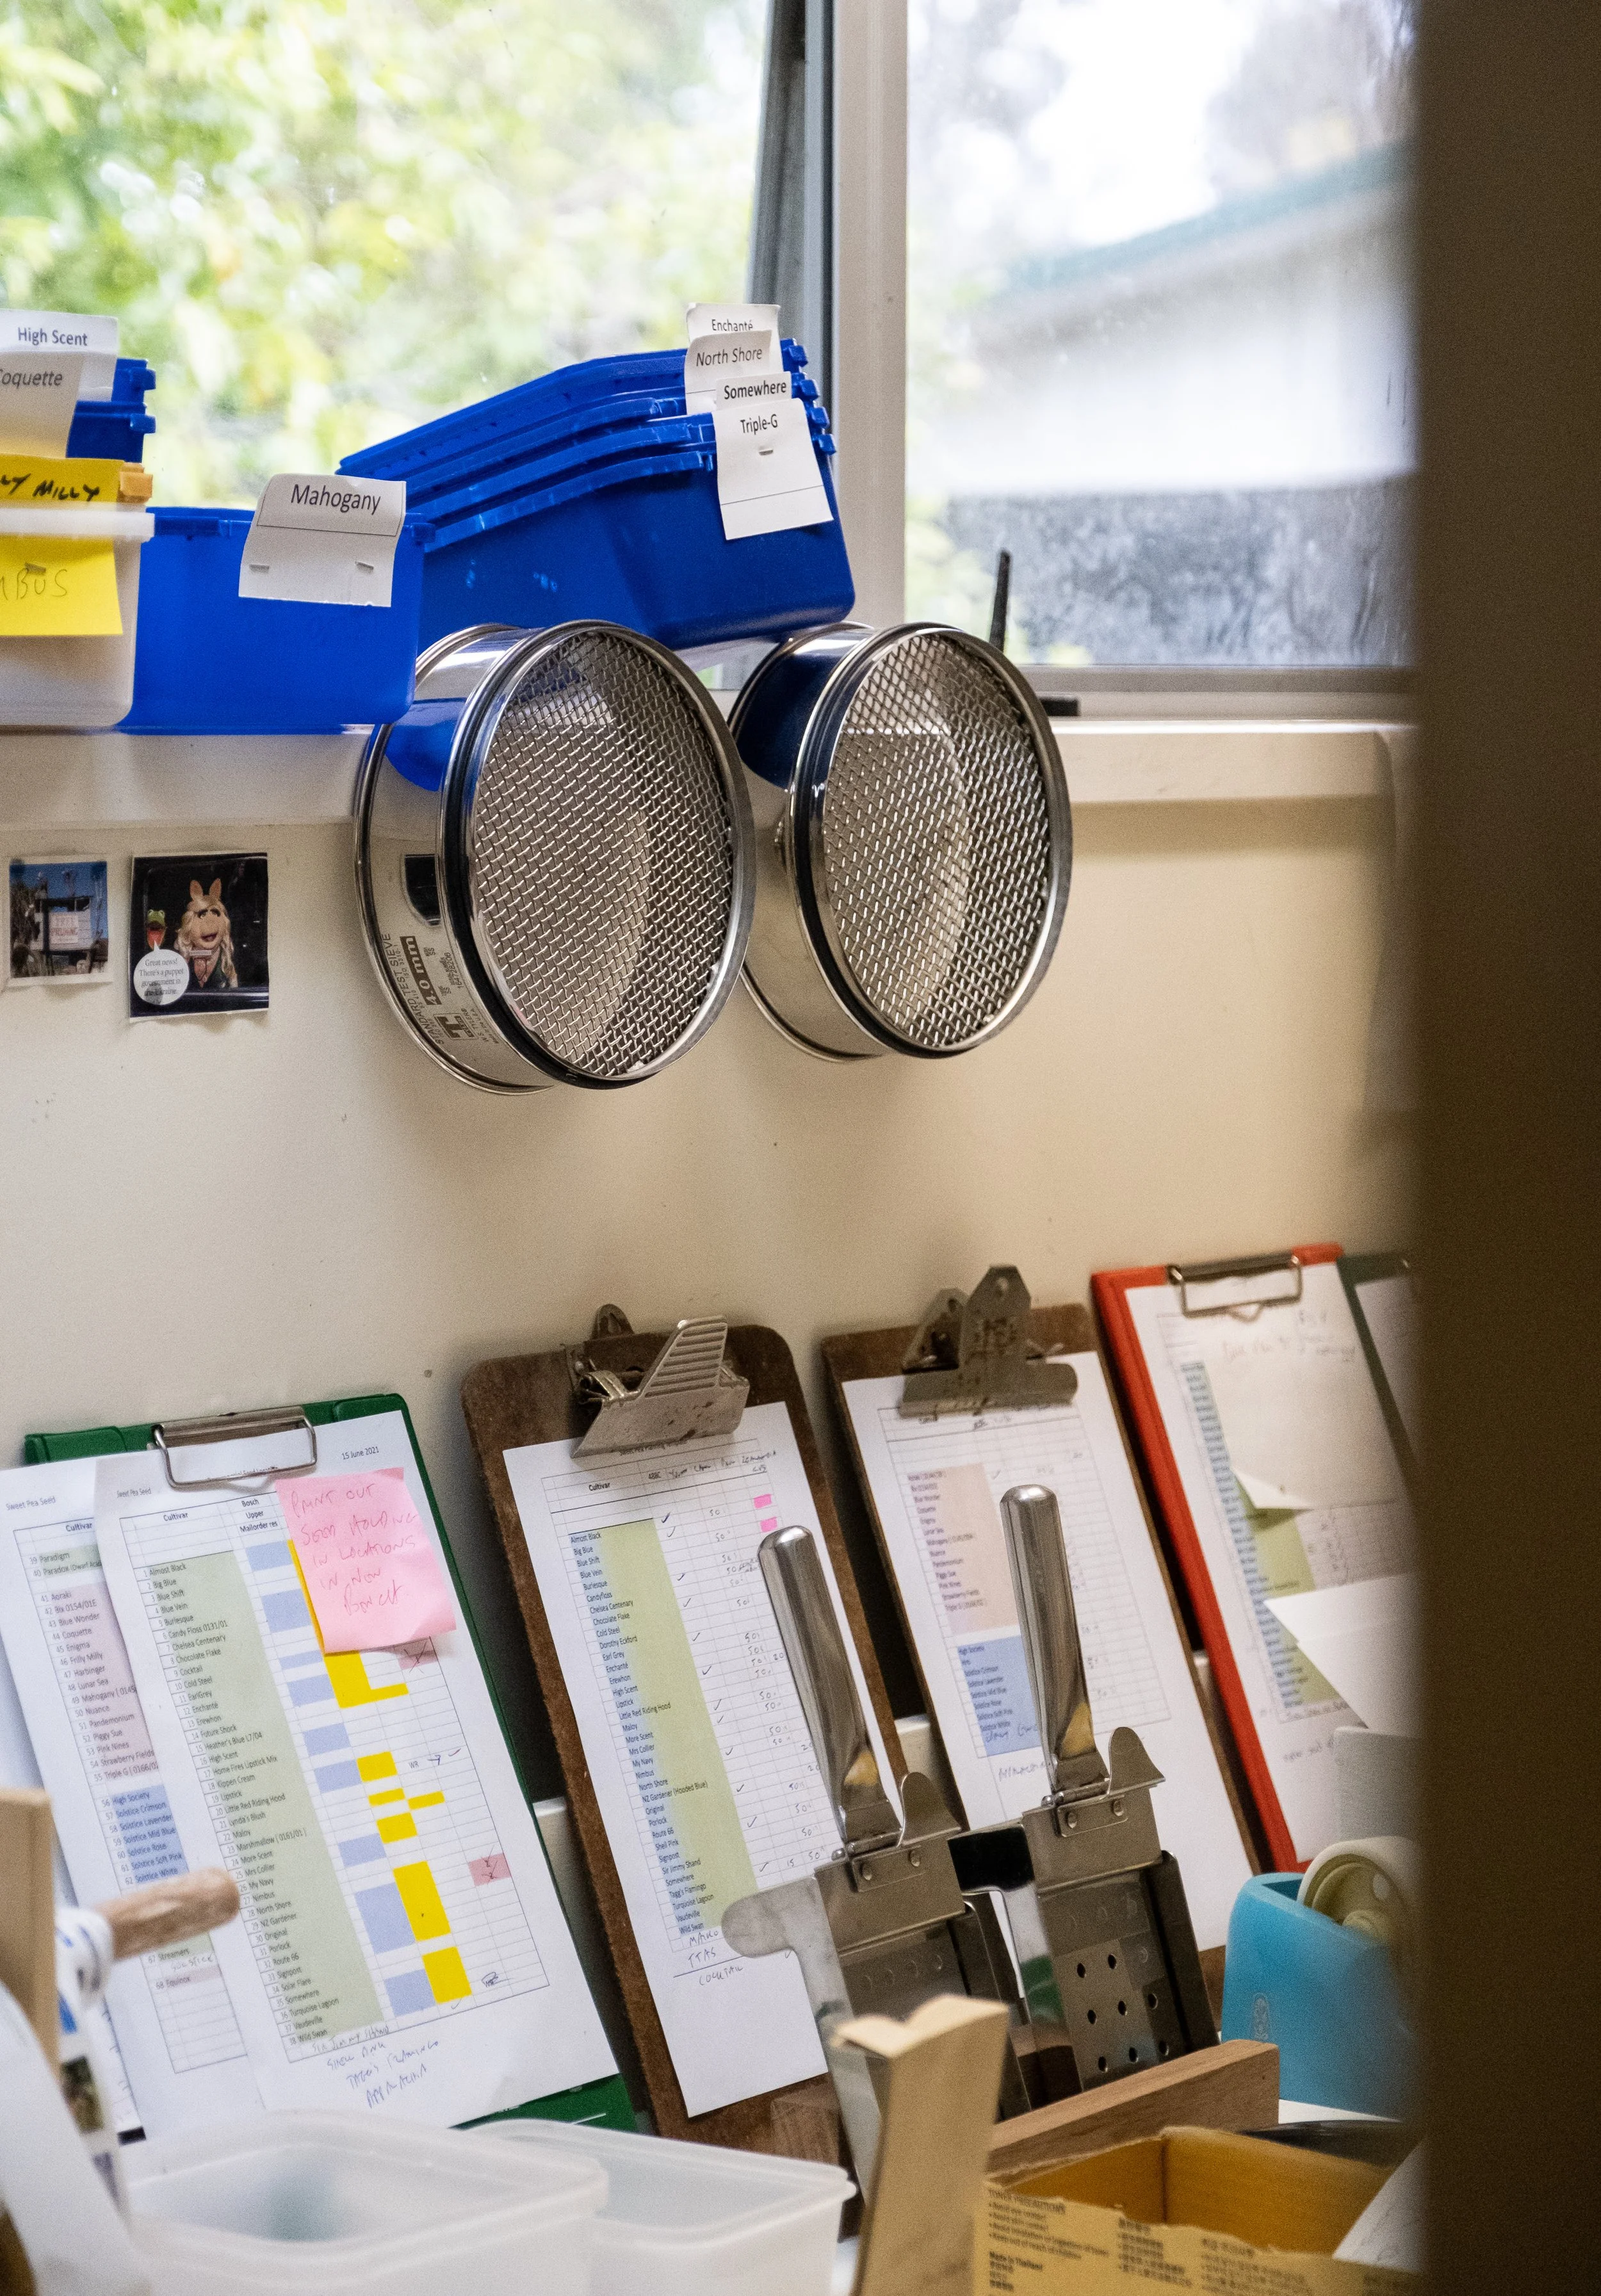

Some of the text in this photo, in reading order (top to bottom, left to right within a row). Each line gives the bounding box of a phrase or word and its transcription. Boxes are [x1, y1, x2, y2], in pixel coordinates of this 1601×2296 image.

[711, 319, 753, 331] Enchanté
[18, 327, 88, 346] High Scent
[696, 346, 763, 367] North Shore
[724, 380, 787, 400] Somewhere
[740, 414, 778, 435] Triple-G
[33, 480, 100, 501] MILLY
[290, 483, 381, 515] Mahogany
[382, 934, 399, 969] SIEVE
[405, 937, 424, 973] mm
[142, 980, 174, 988] government
[394, 969, 411, 996] TEST
[419, 980, 437, 1005] 4.0
[407, 998, 444, 1044] STANDARD
[365, 1446, 379, 1455] 2021
[589, 1482, 610, 1492] Cultivar
[6, 1501, 26, 1511] Sweet
[40, 1496, 56, 1505] Seed
[241, 1498, 259, 1507] Bosch
[163, 1512, 188, 1522] Cultivar
[246, 1510, 264, 1519] Upper
[65, 1523, 93, 1532] Cultivar
[240, 1523, 268, 1533] Mailorder
[571, 1532, 601, 1544] Almost Black
[39, 1552, 70, 1564] Paradigm
[44, 1567, 69, 1576] Paradox
[149, 1567, 170, 1576] Almost
[583, 1581, 607, 1590] Burlesque
[51, 1592, 72, 1601] Aoraki
[156, 1589, 184, 1601] Blue Shift
[587, 1592, 612, 1602] Candyfloss
[160, 1605, 174, 1613] Blue
[590, 1600, 633, 1614] Chelsea Centenary
[58, 1613, 100, 1626] Blue Wonder
[164, 1615, 193, 1626] Burlesque
[593, 1612, 630, 1626] Chocolate Flake
[168, 1628, 186, 1640] Candy
[187, 1626, 202, 1635] Floss
[66, 1642, 90, 1652] Enigma
[172, 1635, 226, 1651] Chelsea Centenary
[599, 1640, 619, 1649] Dorothy
[70, 1652, 103, 1665] Frilly Milly
[175, 1648, 221, 1664] Chocolate Flake
[613, 1651, 624, 1659] Grey
[74, 1665, 105, 1677] Harbinger
[179, 1666, 203, 1677] Cocktail
[77, 1681, 95, 1690] Lunar
[184, 1676, 213, 1689] Cold Steel
[609, 1675, 631, 1685] Erewhon
[81, 1691, 115, 1703] Mahogany
[615, 1699, 634, 1708] Lipstick
[85, 1705, 110, 1715] Nuance
[619, 1712, 632, 1720] Little
[89, 1713, 134, 1728] Pandemonium
[197, 1715, 221, 1726] Erewhon
[205, 1740, 232, 1750] Heather's
[101, 1749, 155, 1767] Strawberry Fields
[636, 1769, 654, 1779] Nimbus
[216, 1774, 256, 1790] Kippen Cream
[225, 1793, 286, 1814] Little Red Riding Hood
[236, 1837, 275, 1852] Marshmallow
